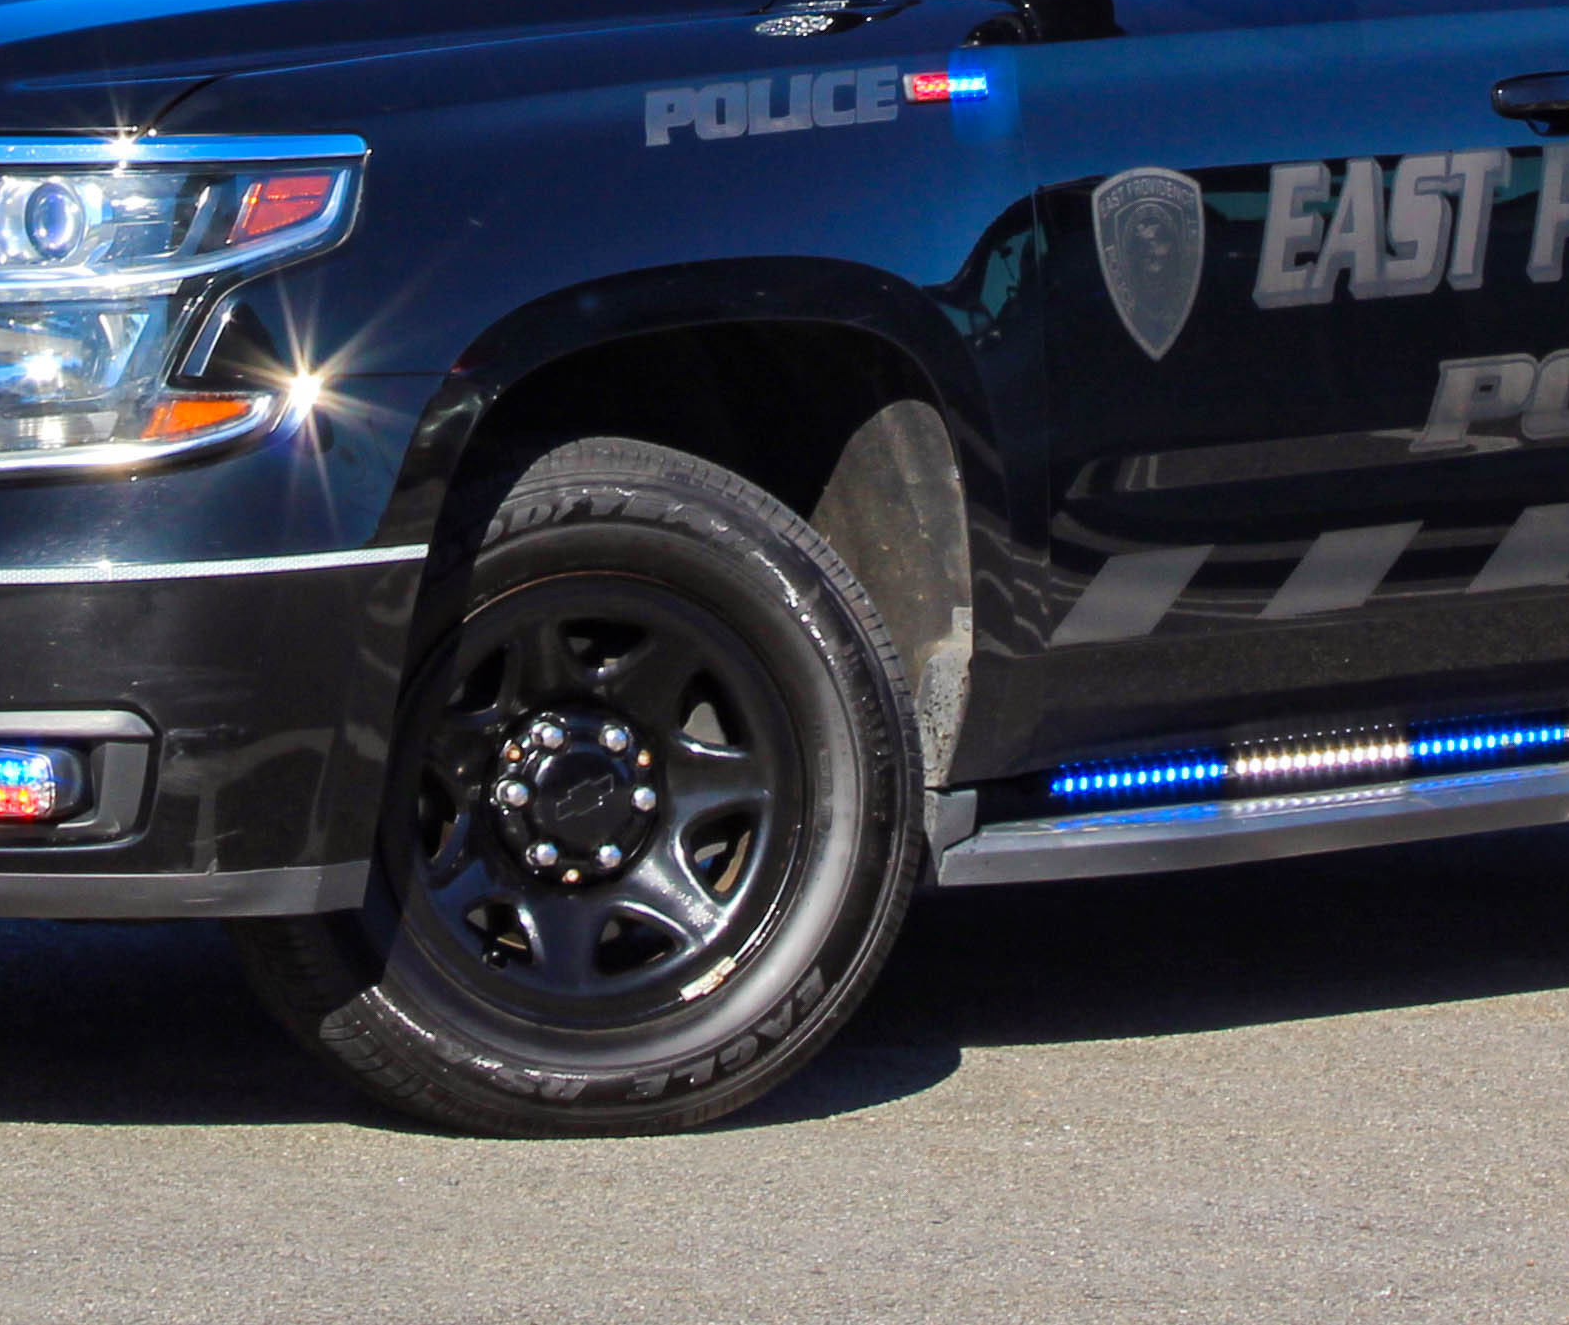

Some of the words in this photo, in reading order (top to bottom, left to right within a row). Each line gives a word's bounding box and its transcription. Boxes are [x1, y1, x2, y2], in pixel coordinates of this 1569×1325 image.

[644, 65, 899, 148] POLICE
[1252, 148, 1512, 310] EAST
[630, 966, 826, 1100] EAGLE
